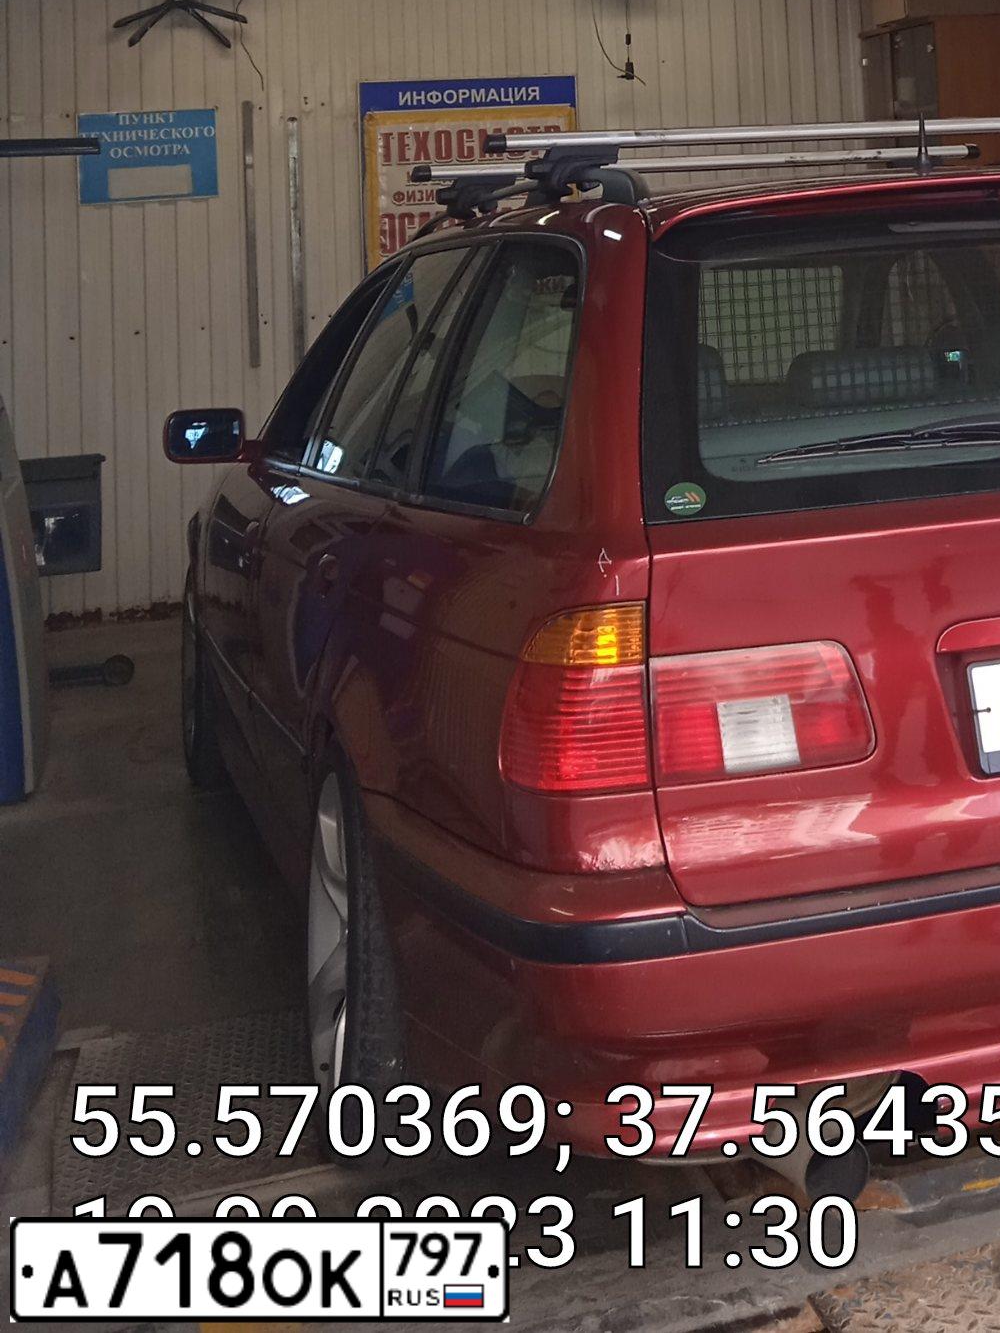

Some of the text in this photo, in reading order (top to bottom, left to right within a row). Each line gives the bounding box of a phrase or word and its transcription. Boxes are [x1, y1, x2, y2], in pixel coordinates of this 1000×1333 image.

[398, 86, 540, 106] ИНФОРМАЦИЯ
[118, 112, 177, 125] ПУНКТ
[109, 144, 190, 159] ОСМОТРА
[381, 125, 562, 164] ТЕХОС
